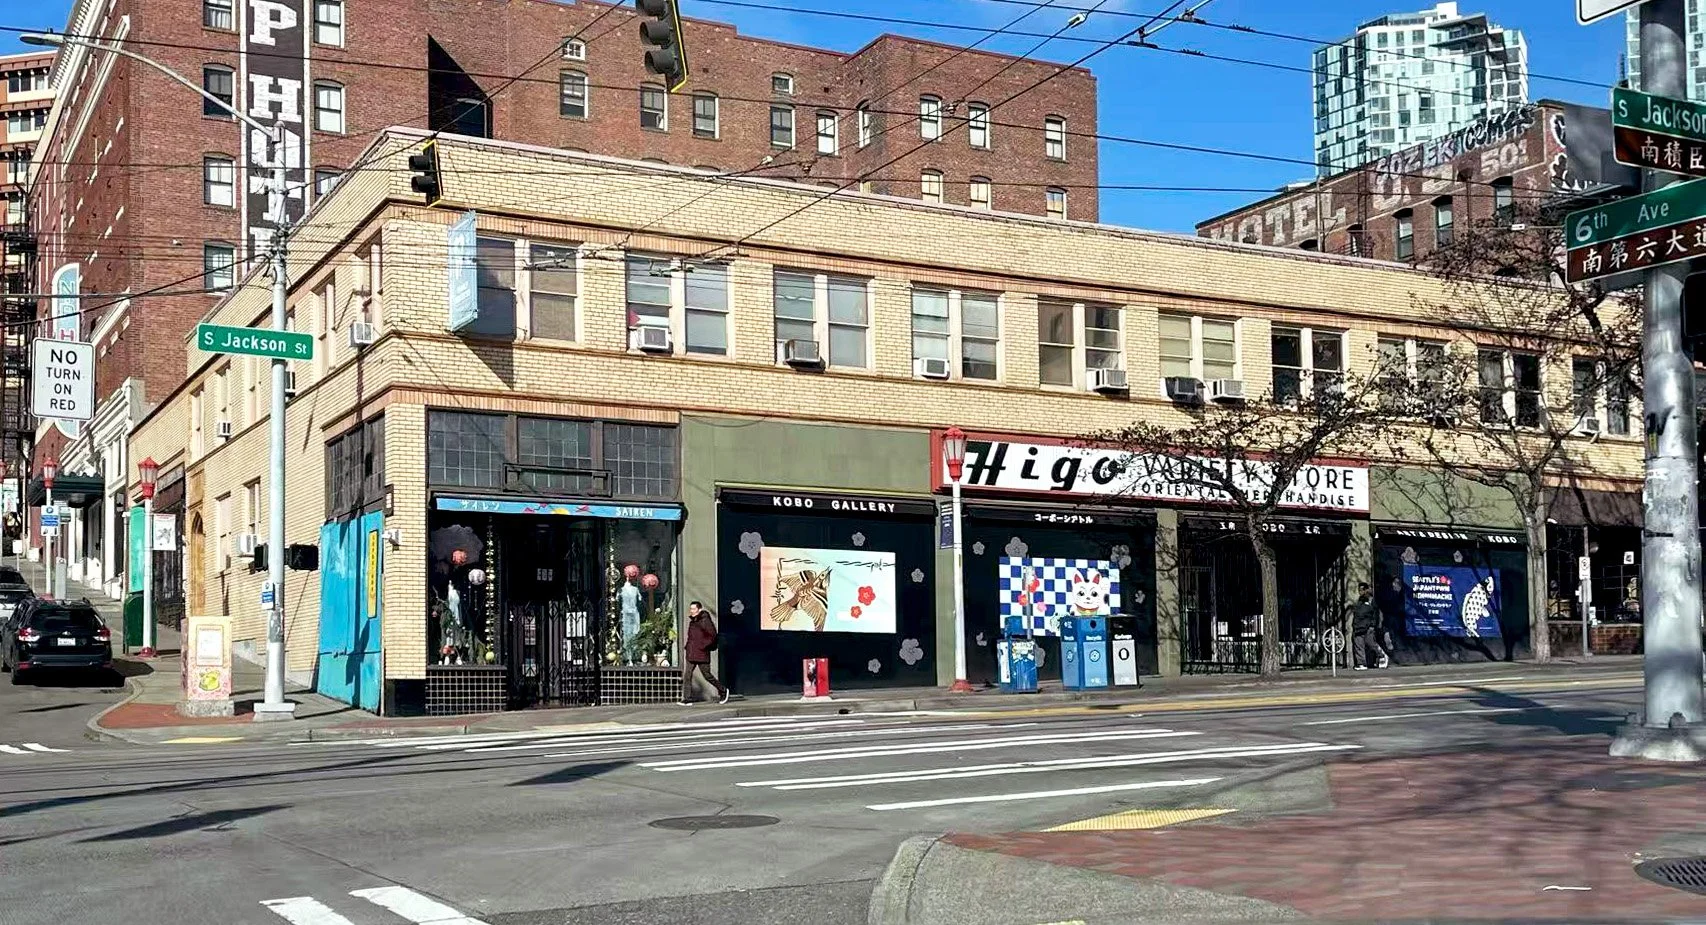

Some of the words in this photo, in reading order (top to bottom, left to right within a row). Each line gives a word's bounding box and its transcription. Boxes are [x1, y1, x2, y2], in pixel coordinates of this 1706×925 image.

[1618, 99, 1628, 118] S
[1575, 210, 1608, 243] 6th
[1637, 201, 1670, 224] Ave
[204, 332, 214, 346] S
[221, 332, 287, 353] Jackson
[294, 341, 307, 355] St
[50, 349, 78, 365] NO
[46, 366, 81, 381] TURN
[54, 383, 72, 395] ON
[50, 398, 76, 411] RED
[964, 440, 1124, 491] Higo
[773, 496, 814, 509] KOBO
[831, 500, 895, 513] GALLERY
[1242, 488, 1355, 506] MERHANDISE
[615, 506, 653, 518] SAIREN
[1487, 535, 1518, 544] KOBO
